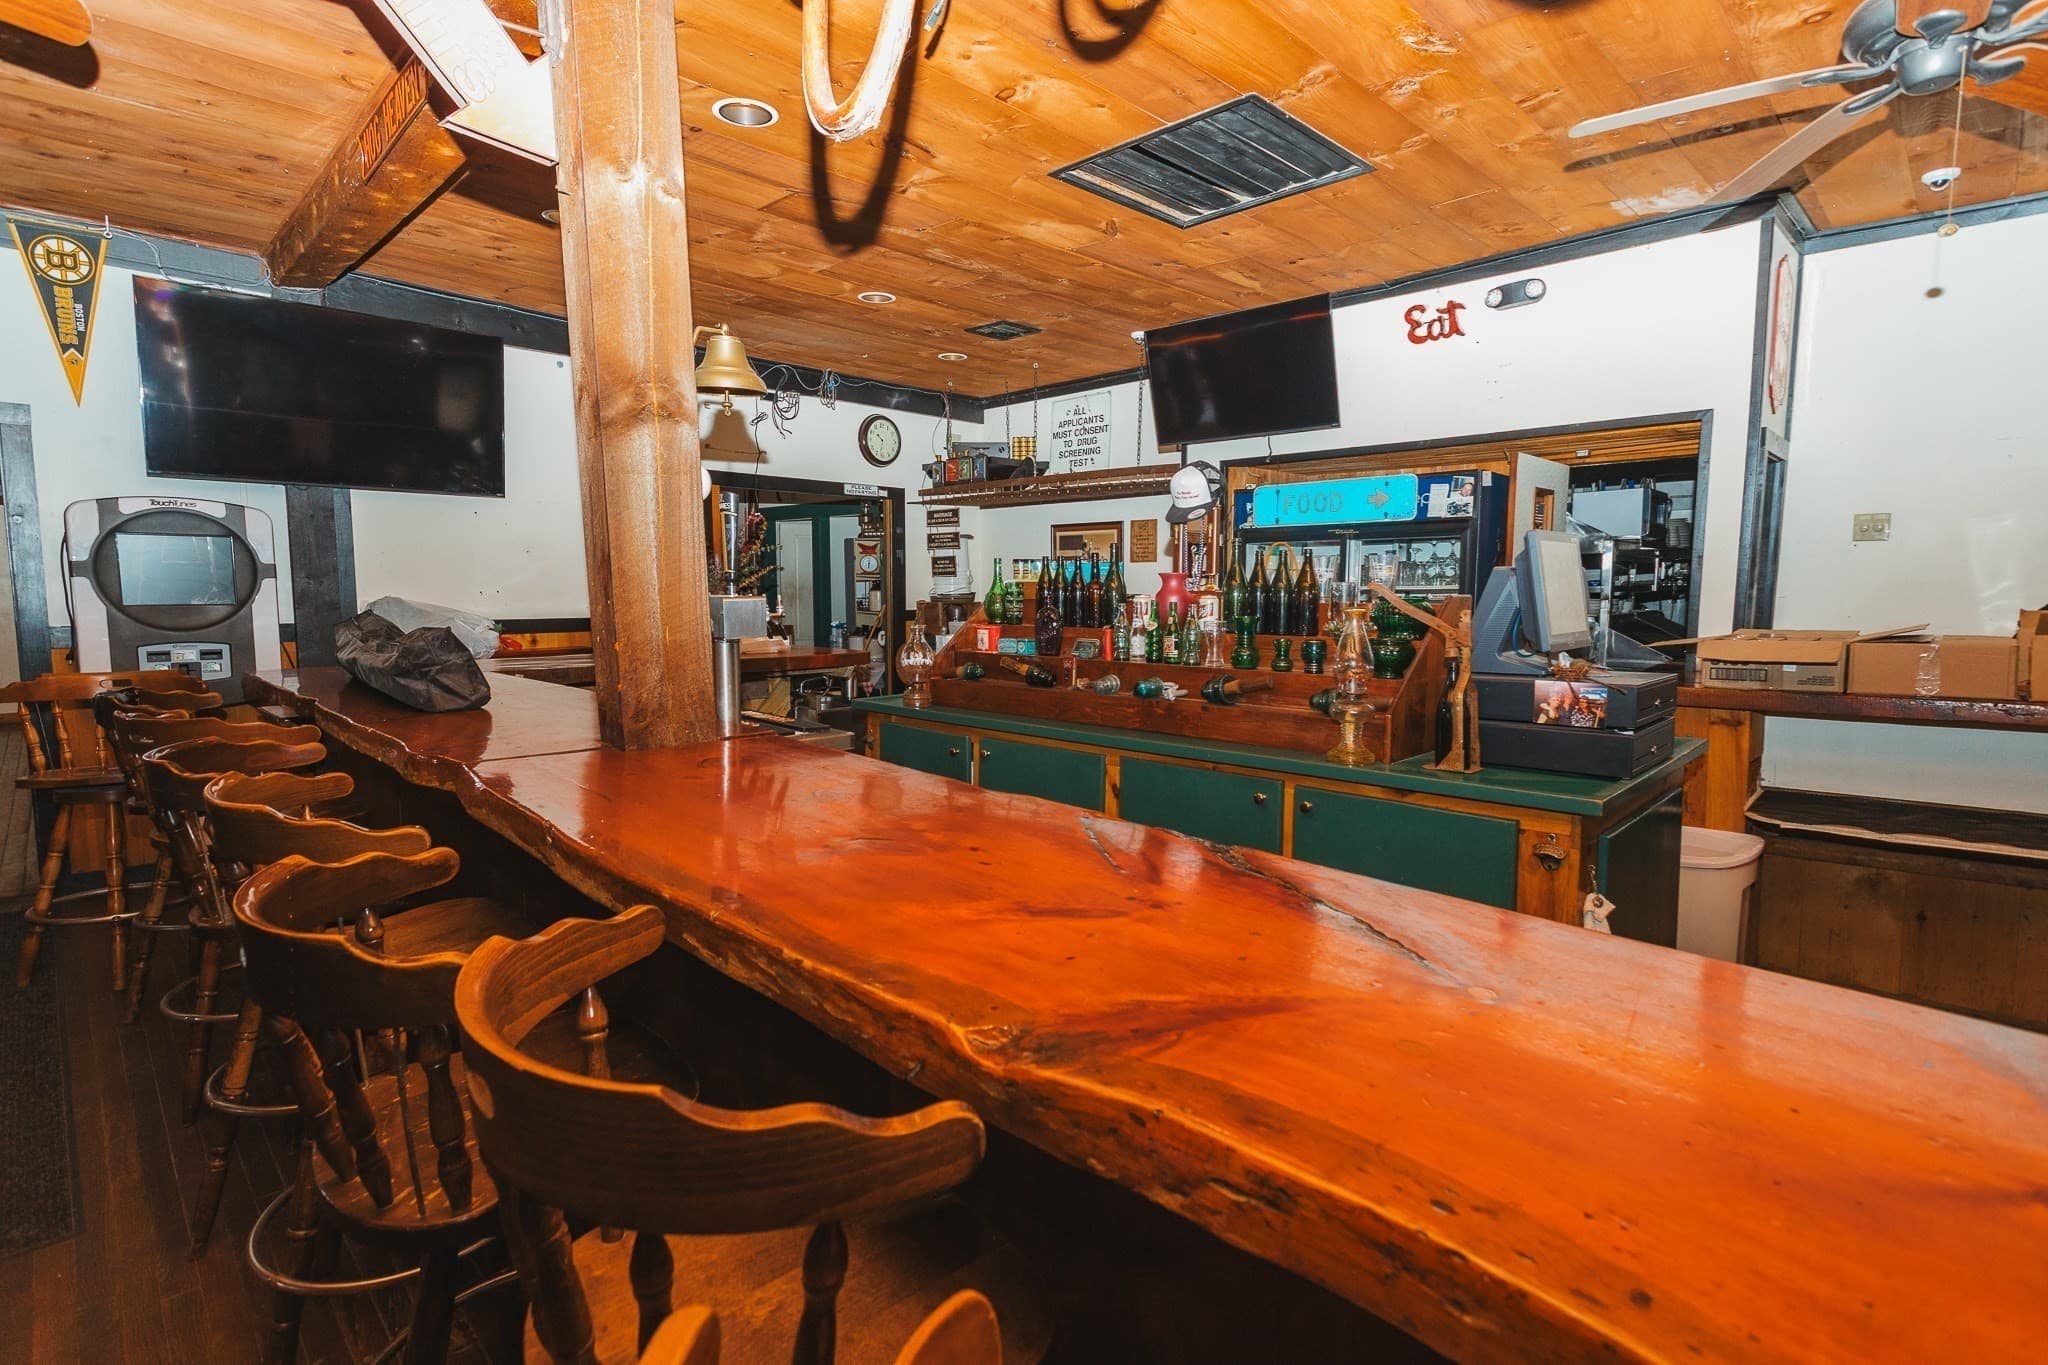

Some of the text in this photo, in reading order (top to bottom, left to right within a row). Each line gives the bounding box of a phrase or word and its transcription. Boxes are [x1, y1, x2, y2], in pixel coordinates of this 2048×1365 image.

[362, 60, 420, 170] HOG HEAVEN
[53, 285, 79, 345] BRUINS
[75, 303, 86, 332] BOSTON
[1404, 299, 1467, 345] Eat
[1058, 414, 1105, 429] APPLICANTS
[1073, 407, 1087, 416] ALL
[1052, 424, 1110, 440] MUST CONSENT
[1058, 446, 1101, 459] SCREENING
[1063, 437, 1098, 448] TO DRUG
[1282, 491, 1346, 515] FOOD
